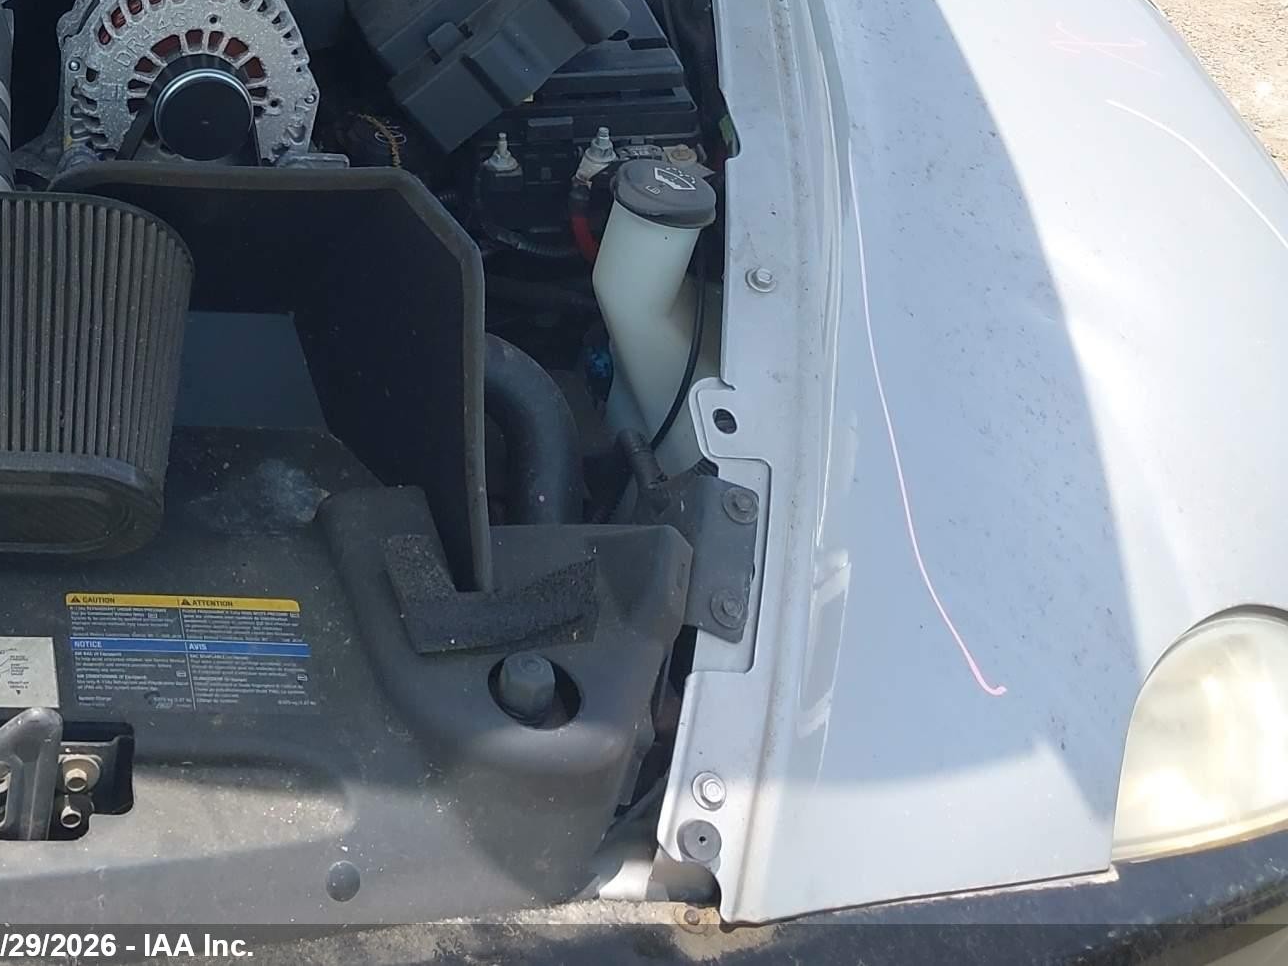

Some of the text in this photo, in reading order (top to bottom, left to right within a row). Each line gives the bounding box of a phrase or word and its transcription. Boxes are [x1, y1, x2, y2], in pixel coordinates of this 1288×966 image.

[82, 596, 116, 604] CAUTION
[192, 599, 234, 607] ATTENTION
[73, 640, 103, 648] NOTICE
[188, 643, 208, 651] AVIS
